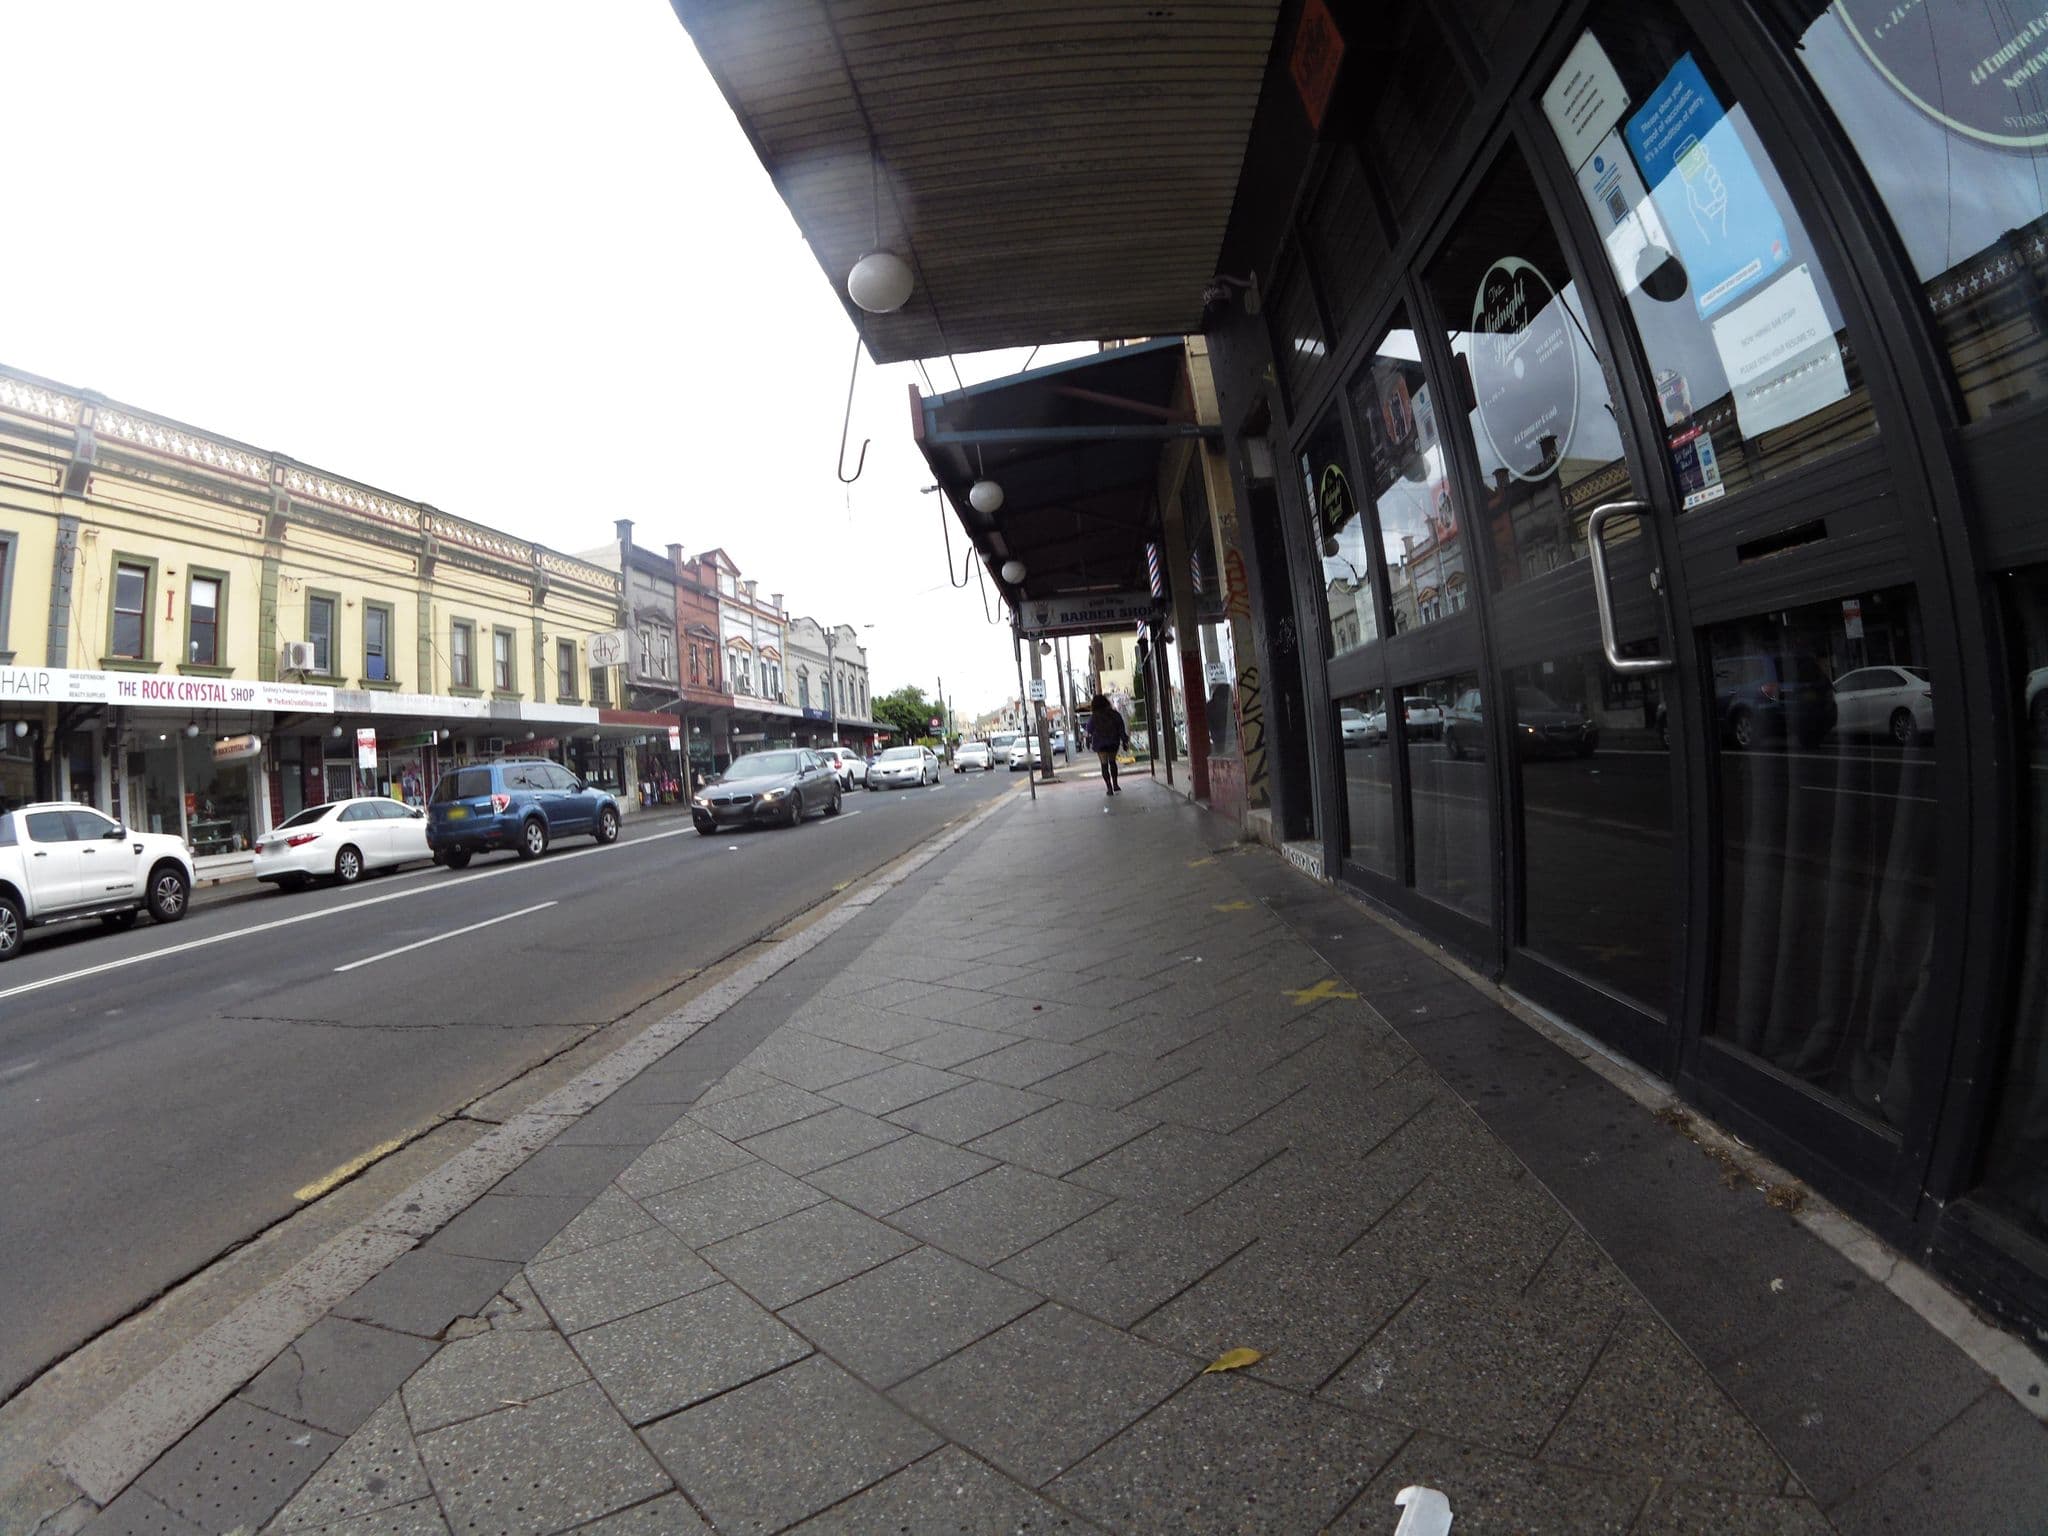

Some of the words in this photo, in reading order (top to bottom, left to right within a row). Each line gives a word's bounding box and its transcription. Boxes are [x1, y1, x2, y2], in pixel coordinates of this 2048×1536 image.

[1641, 112, 1660, 133] Please
[1659, 96, 1673, 114] show
[1672, 80, 1684, 100] your
[1643, 128, 1659, 150] proof
[1658, 119, 1684, 150] condition
[1488, 284, 1505, 303] The
[1060, 609, 1115, 623] BARBER
[1, 671, 50, 695] HAIR
[118, 680, 137, 697] THE
[142, 680, 175, 700] ROCK
[178, 682, 228, 702] CRYSTAL
[231, 687, 255, 702] SHOP
